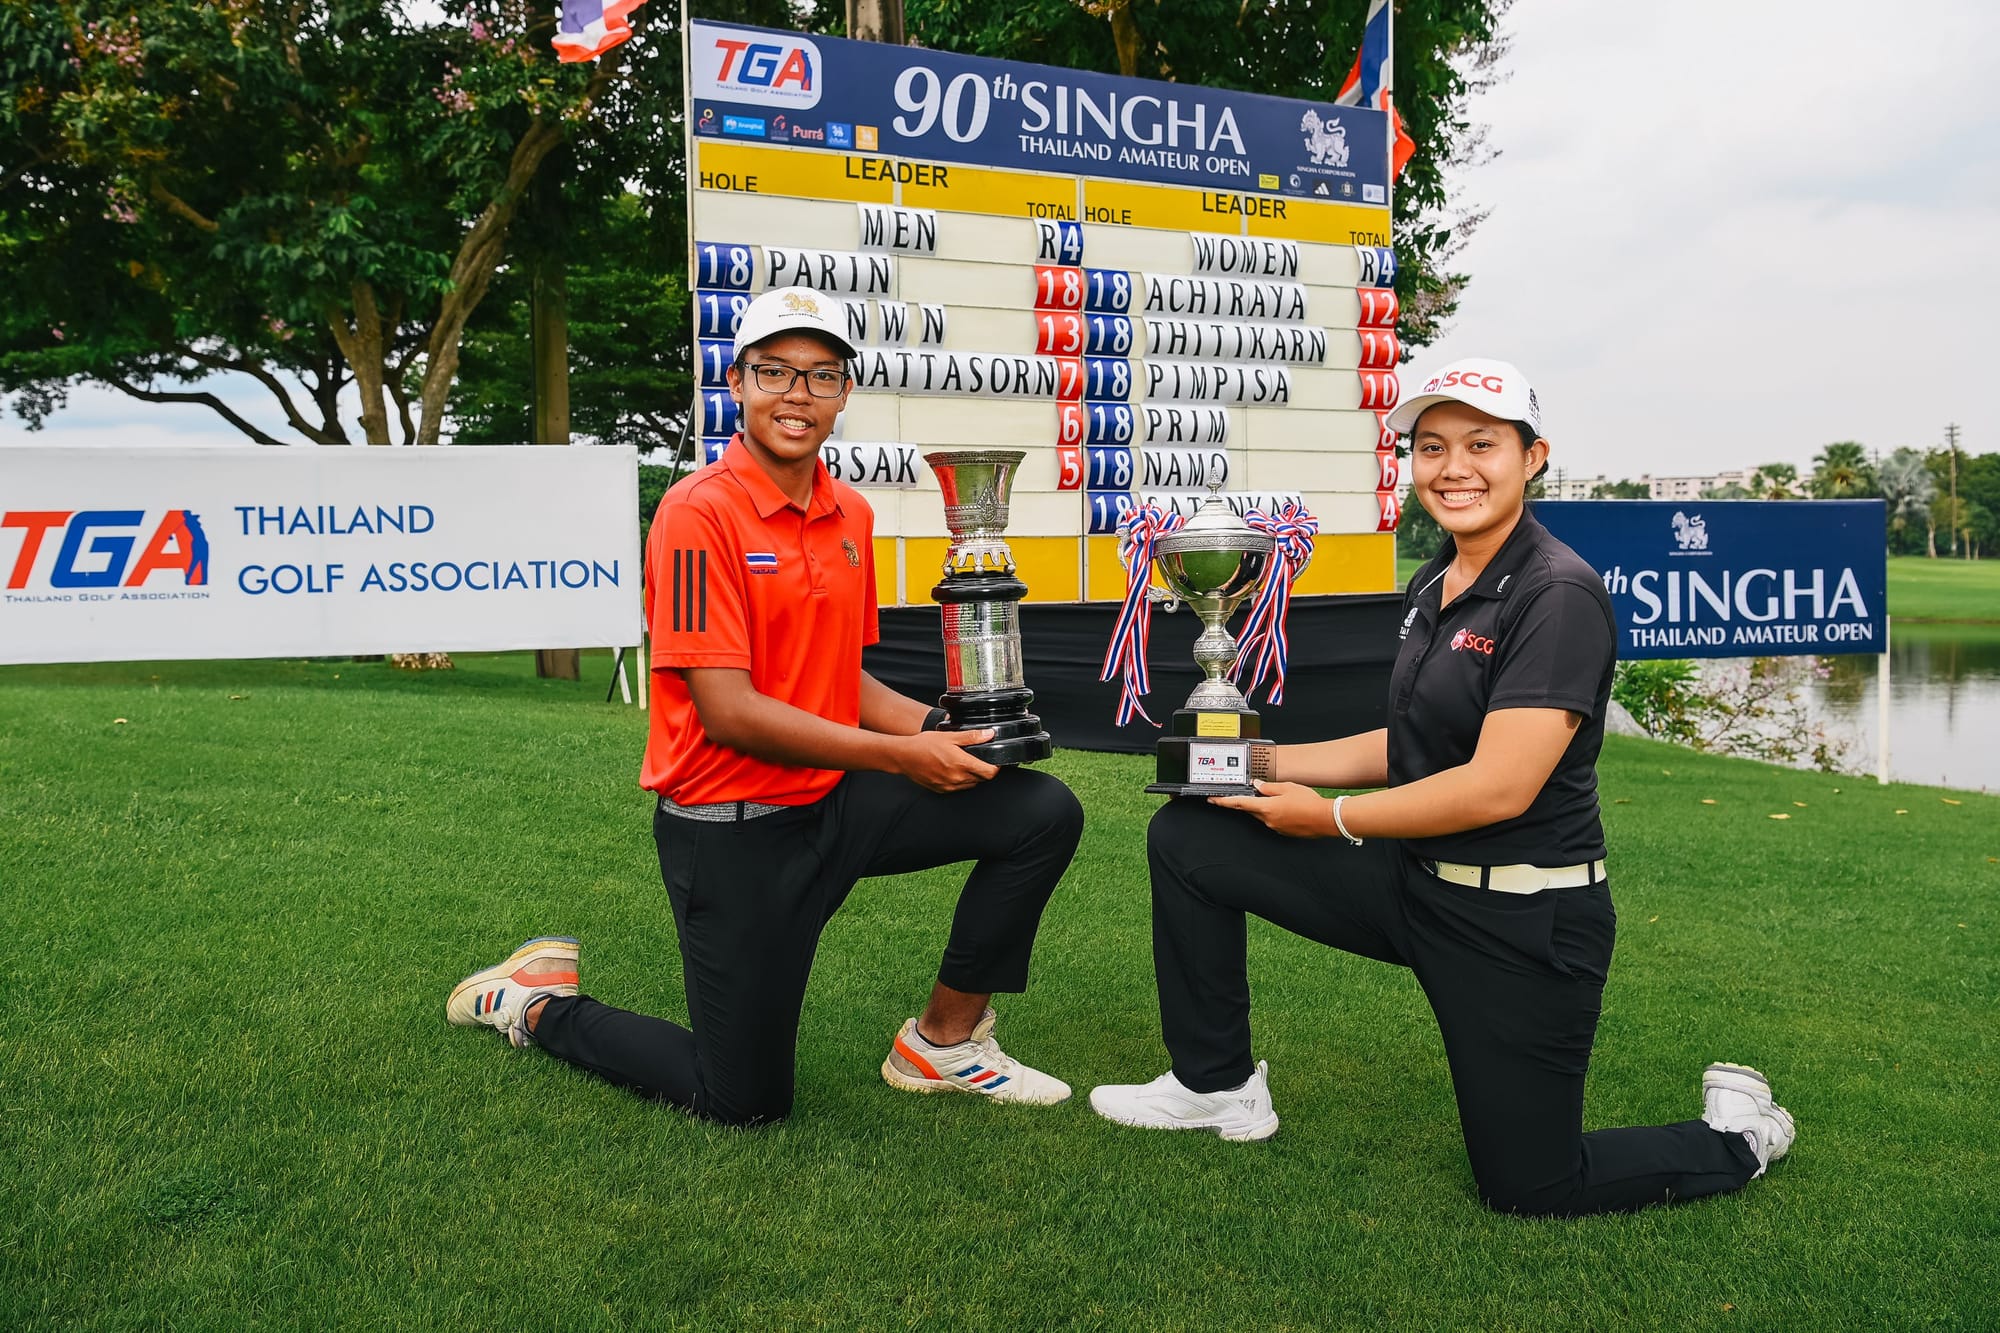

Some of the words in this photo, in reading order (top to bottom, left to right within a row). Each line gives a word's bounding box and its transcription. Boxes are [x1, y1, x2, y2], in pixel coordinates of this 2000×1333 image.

[715, 39, 812, 91] TGA
[892, 66, 1018, 144] 90th
[1020, 80, 1247, 155] SINGHA
[845, 156, 949, 188] LEADER
[1018, 134, 1112, 161] THAILAND
[1118, 147, 1200, 172] AMATEUR
[1205, 156, 1250, 177] OPEN
[700, 171, 758, 193] HOLE
[1026, 202, 1076, 221] TOTAL
[1084, 205, 1132, 226] HOLE
[1202, 192, 1287, 219] LEADER
[863, 207, 936, 252] MEN
[1040, 223, 1081, 262] R4
[1349, 231, 1389, 248] TOTAL
[704, 245, 749, 287] 18
[768, 249, 890, 294] PARIN
[1043, 269, 1079, 306] 18
[1193, 236, 1298, 278] WOMEN
[1359, 250, 1395, 283] R4
[1093, 271, 1129, 310] 18
[1145, 277, 1305, 320] ACHIRAYA
[1365, 292, 1396, 325] 12
[706, 294, 749, 335] 18
[1044, 314, 1080, 352] 13
[1093, 316, 1130, 352] 18
[1151, 321, 1326, 363] THITIKARN
[1365, 333, 1392, 366] 11
[708, 344, 722, 383] 1
[848, 350, 1057, 397] NATTASORN
[1063, 362, 1078, 396] 7
[1092, 359, 1129, 397] 18
[1148, 363, 1289, 403] PIMPISA
[1365, 374, 1398, 406] 10
[1443, 371, 1503, 394] SCG
[1062, 406, 1079, 443] 6
[1093, 404, 1131, 442] 18
[1147, 408, 1226, 444] PRIM
[1063, 451, 1079, 486] 5
[1095, 450, 1130, 487] 18
[1143, 451, 1229, 487] NAMO
[1383, 455, 1397, 488] 6
[234, 505, 434, 535] THAILAND
[1382, 495, 1397, 528] 4
[1, 509, 209, 589] TGA
[237, 564, 345, 596] GOLF
[360, 559, 620, 593] ASSOCIATION
[1631, 567, 1869, 625] SINGHA
[5, 594, 72, 604] THAILAND
[78, 593, 115, 602] GOLF
[120, 591, 210, 601] ASSOCIATION
[1464, 633, 1494, 655] SCG
[1629, 627, 1726, 648] THAILAND
[1732, 624, 1818, 645] AMATEUR
[1824, 622, 1873, 642] OPEN
